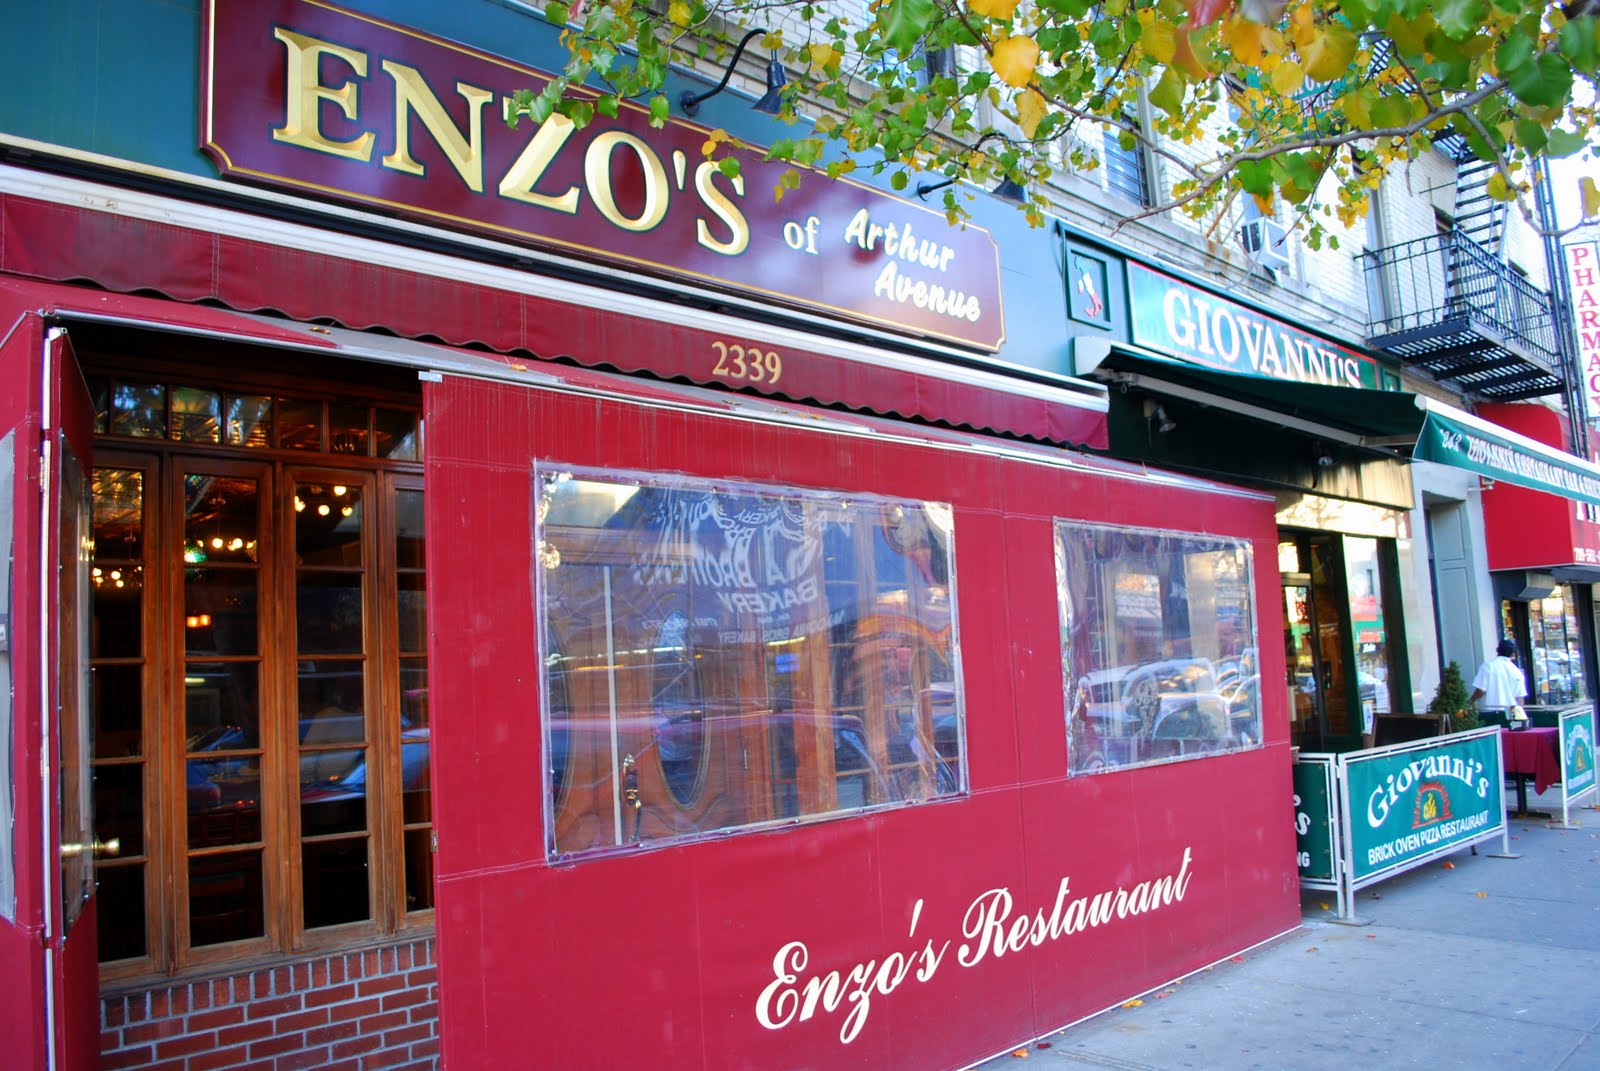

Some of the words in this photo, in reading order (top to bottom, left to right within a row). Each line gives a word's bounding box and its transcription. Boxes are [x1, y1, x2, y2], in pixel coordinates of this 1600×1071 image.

[273, 26, 750, 257] ENZO'S
[783, 216, 820, 255] of
[844, 208, 955, 272] Arthur
[874, 260, 981, 322] Avenue
[711, 341, 783, 384] 2339
[1163, 287, 1362, 390] GIOVANNI'S
[1367, 754, 1490, 828] Giovanni's
[1368, 838, 1396, 865] BRICK
[1395, 833, 1420, 855] OVEN
[1420, 826, 1441, 846] PIZZA
[1440, 810, 1489, 839] RESTAURANT
[755, 898, 951, 1045] Enzo's
[957, 846, 1193, 968] Restaurant
